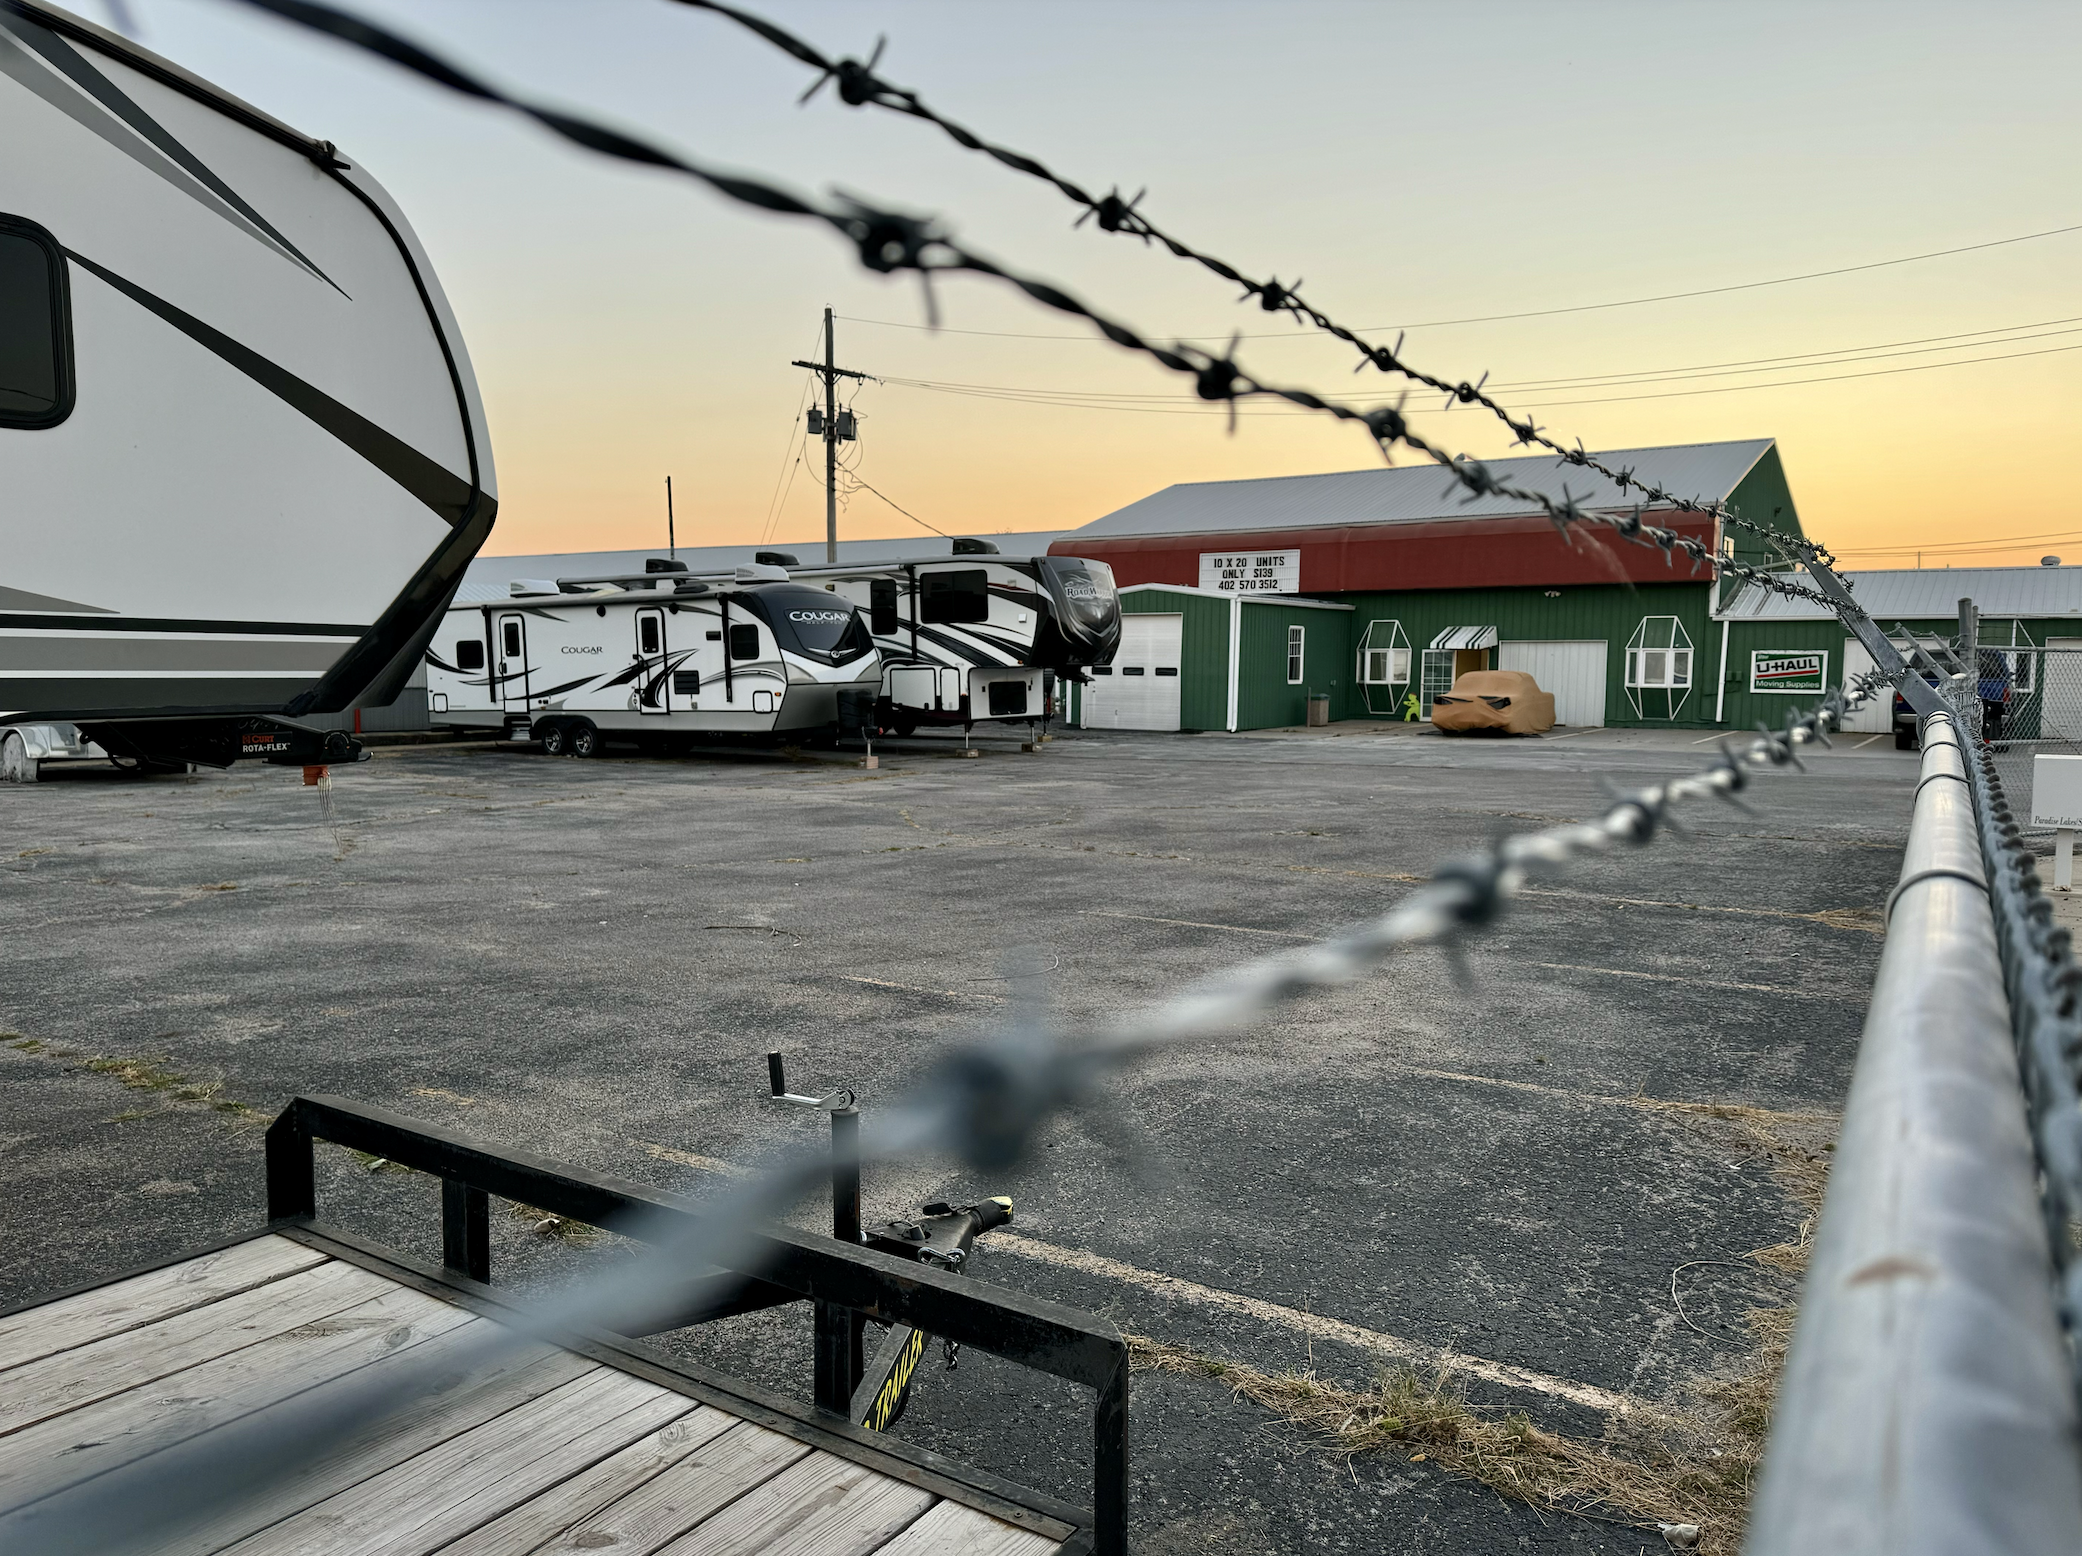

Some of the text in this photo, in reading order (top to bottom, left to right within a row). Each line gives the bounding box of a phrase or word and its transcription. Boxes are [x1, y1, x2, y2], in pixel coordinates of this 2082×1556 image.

[1213, 556, 1285, 568] 10 X 20 UNITS
[1222, 569, 1245, 579] ONLY
[1218, 579, 1278, 590] 402 570 3512
[789, 611, 851, 622] COUGAR
[561, 646, 603, 655] COUGAR
[1756, 658, 1818, 673] U-HAUL
[1755, 680, 1820, 688] Moving Supplies
[251, 734, 275, 744] CURT
[876, 1329, 924, 1432] TRAILER
